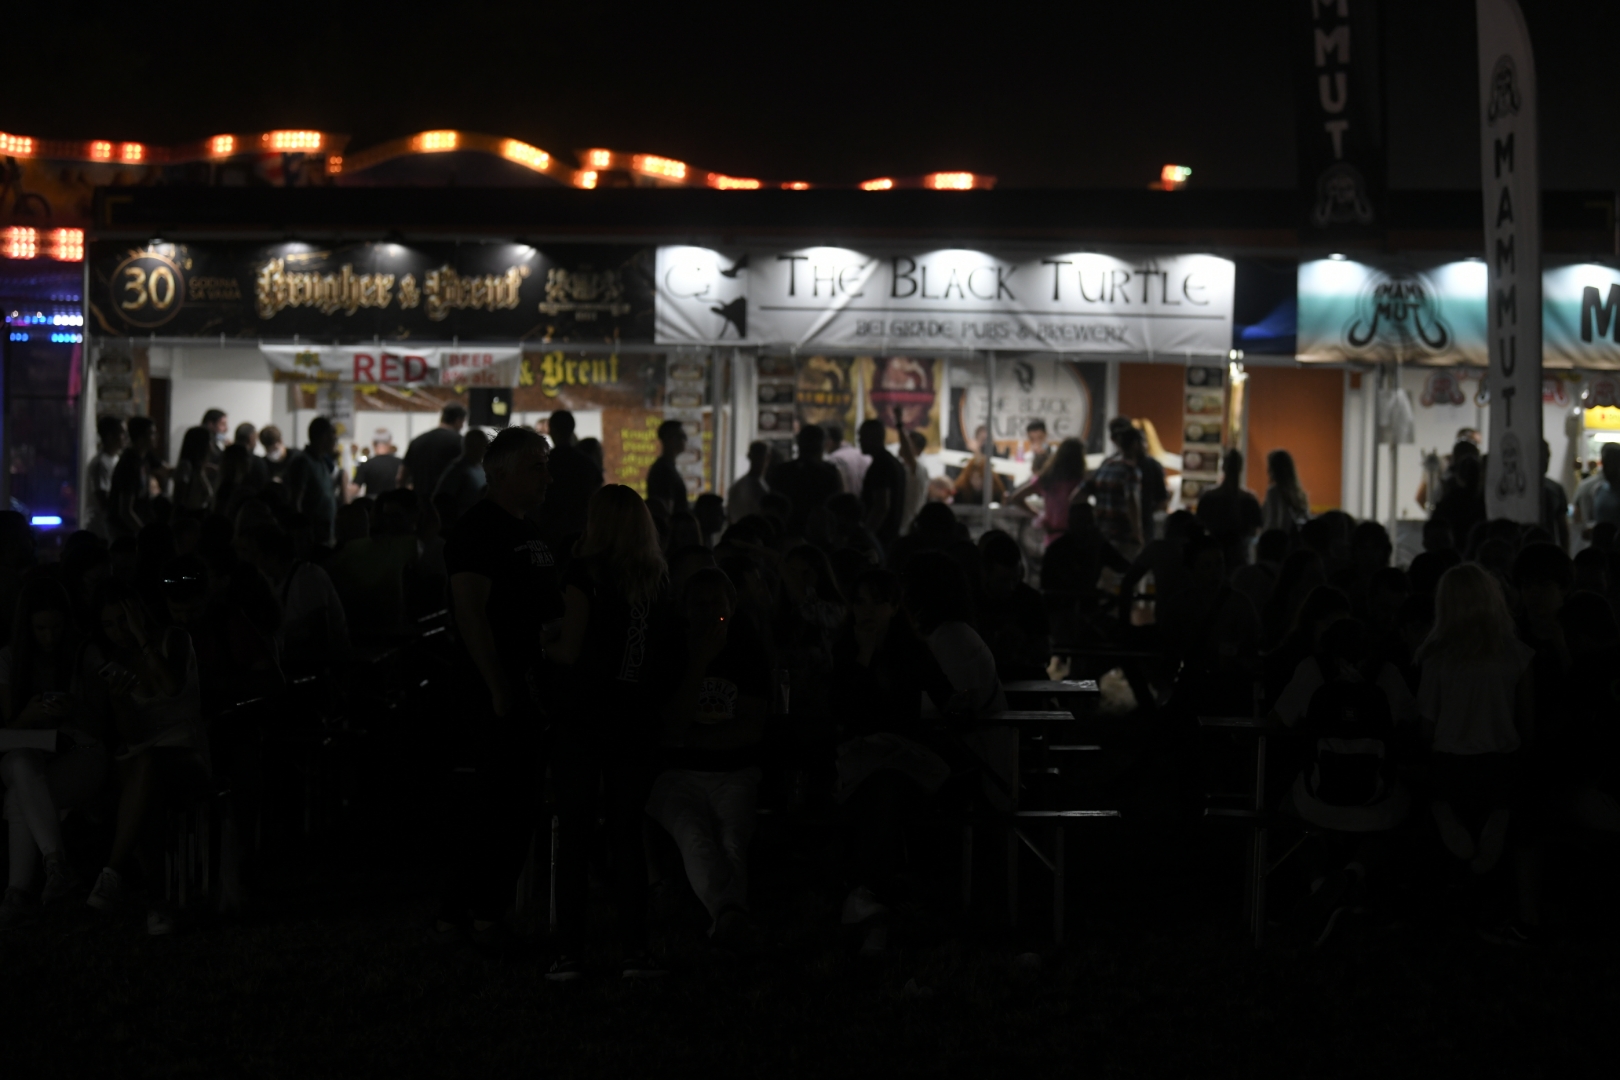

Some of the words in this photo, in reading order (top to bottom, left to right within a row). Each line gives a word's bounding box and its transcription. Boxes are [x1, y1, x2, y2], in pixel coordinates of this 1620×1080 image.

[121, 265, 176, 311] 30
[398, 273, 420, 310] &
[777, 255, 865, 299] THE
[891, 256, 1016, 303] BLACK
[1041, 259, 1210, 307] TURTLE
[1494, 132, 1515, 428] MAMMUT
[856, 319, 951, 338] BELGRADE
[961, 321, 1009, 339] PUBS
[1038, 324, 1129, 342] BREWERY
[353, 354, 428, 382] RED
[449, 354, 493, 367] BEER
[519, 360, 535, 386] &
[541, 352, 619, 397] Brent
